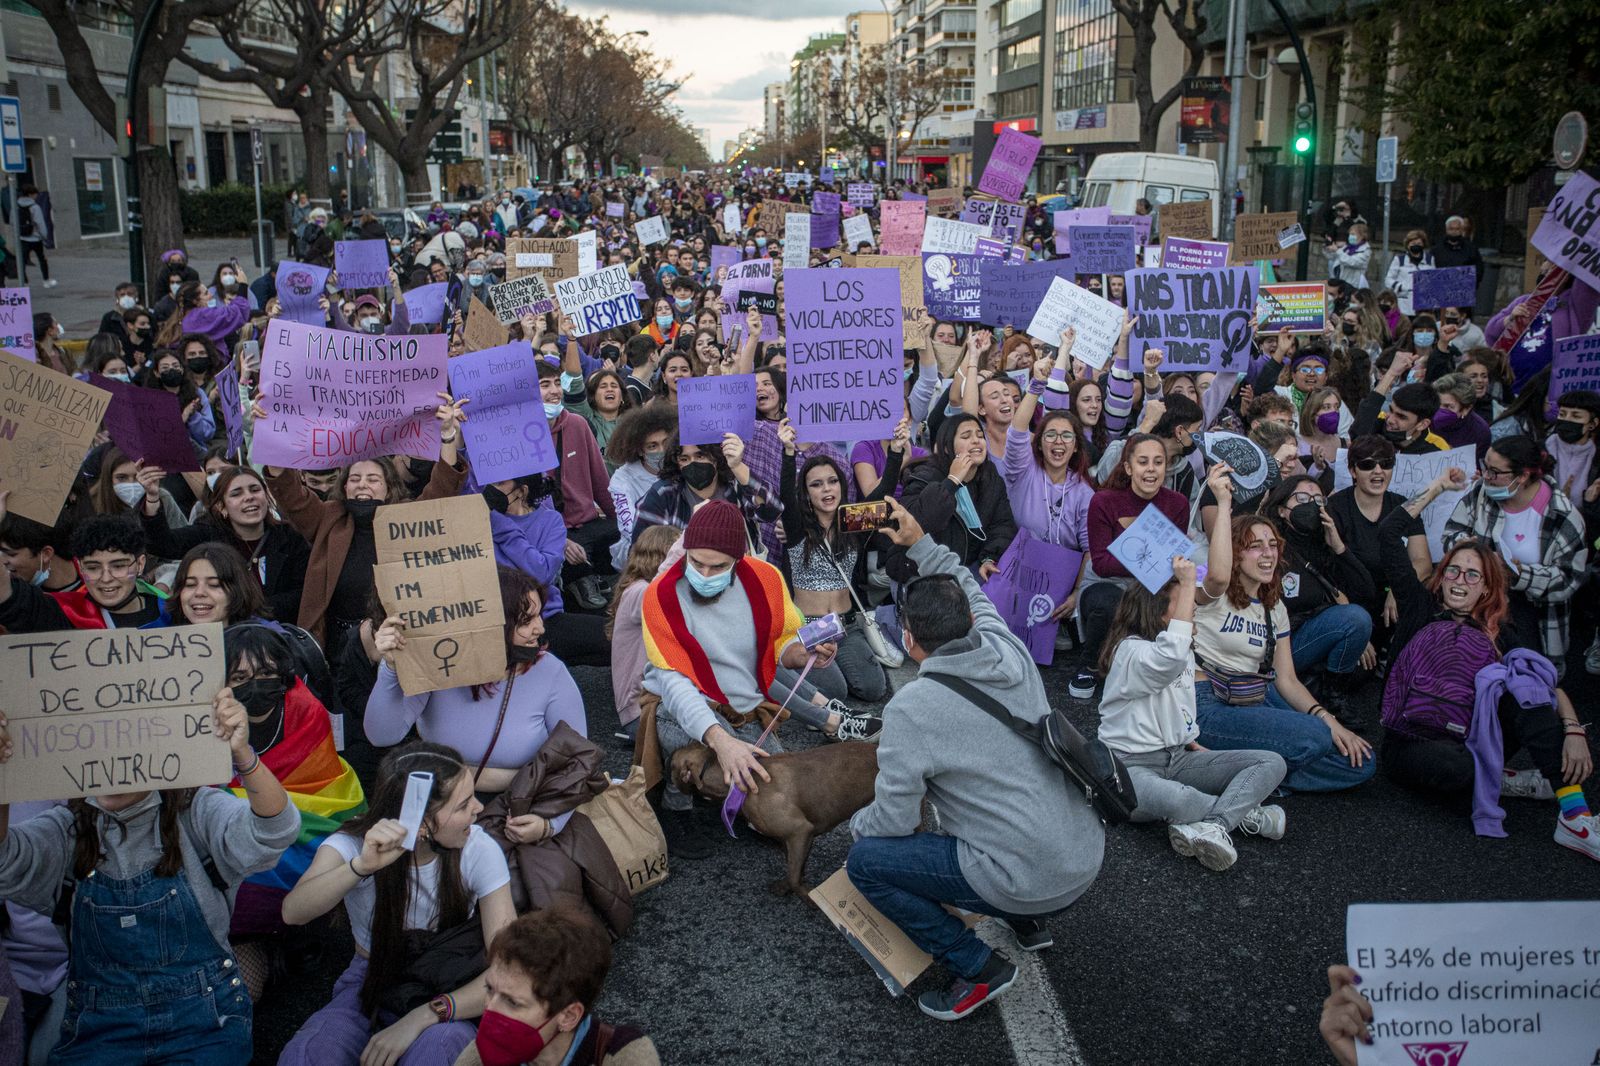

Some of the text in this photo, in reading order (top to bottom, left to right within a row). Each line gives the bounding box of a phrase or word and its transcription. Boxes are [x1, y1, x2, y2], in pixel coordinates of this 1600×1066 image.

[977, 214, 1009, 227] GRTO
[1009, 205, 1023, 218] EL
[1556, 200, 1600, 238] NO
[1179, 247, 1202, 256] PORNO
[1203, 249, 1213, 257] ES
[1241, 242, 1280, 257] JUNTAS
[558, 266, 627, 297] NO QUIERO TU
[727, 262, 771, 281] EL PORNO
[561, 279, 632, 309] PIROPO QUIERO
[823, 280, 865, 303] LOS
[1134, 272, 1175, 311] NOS
[1238, 270, 1251, 310] A
[583, 292, 642, 334] RESPETO
[789, 307, 896, 330] VIOLADORES
[278, 329, 293, 347] EL
[792, 338, 894, 365] EXISTIERON
[1163, 340, 1211, 365] TODAS
[274, 361, 439, 385] ES UNA ENFERMEDAD
[790, 367, 898, 394] ANTES DE LAS
[273, 383, 294, 399] DE
[680, 383, 691, 394] NO
[4, 398, 29, 418] QUE
[273, 402, 306, 417] ORAL
[333, 406, 349, 419] SU
[358, 407, 404, 422] VACUNA
[798, 398, 892, 425] MINIFALDAS
[273, 419, 289, 433] LA
[1394, 459, 1424, 484] LAS
[388, 518, 447, 541] DIVINE
[394, 580, 423, 601] I'M
[399, 598, 488, 631] FEMENINE
[1219, 611, 1245, 633] LOS
[8, 632, 213, 679] TE CANSAS
[40, 687, 84, 714] DE
[21, 713, 213, 758] NOSOTRAS DE
[62, 752, 181, 792] VIVIRLO
[1356, 947, 1376, 969] El
[1384, 947, 1435, 969] 34%
[1442, 945, 1472, 968] de
[1480, 945, 1575, 972] mujeres
[1359, 980, 1440, 1003] sufrido
[1365, 1012, 1542, 1039] entorno laboral
